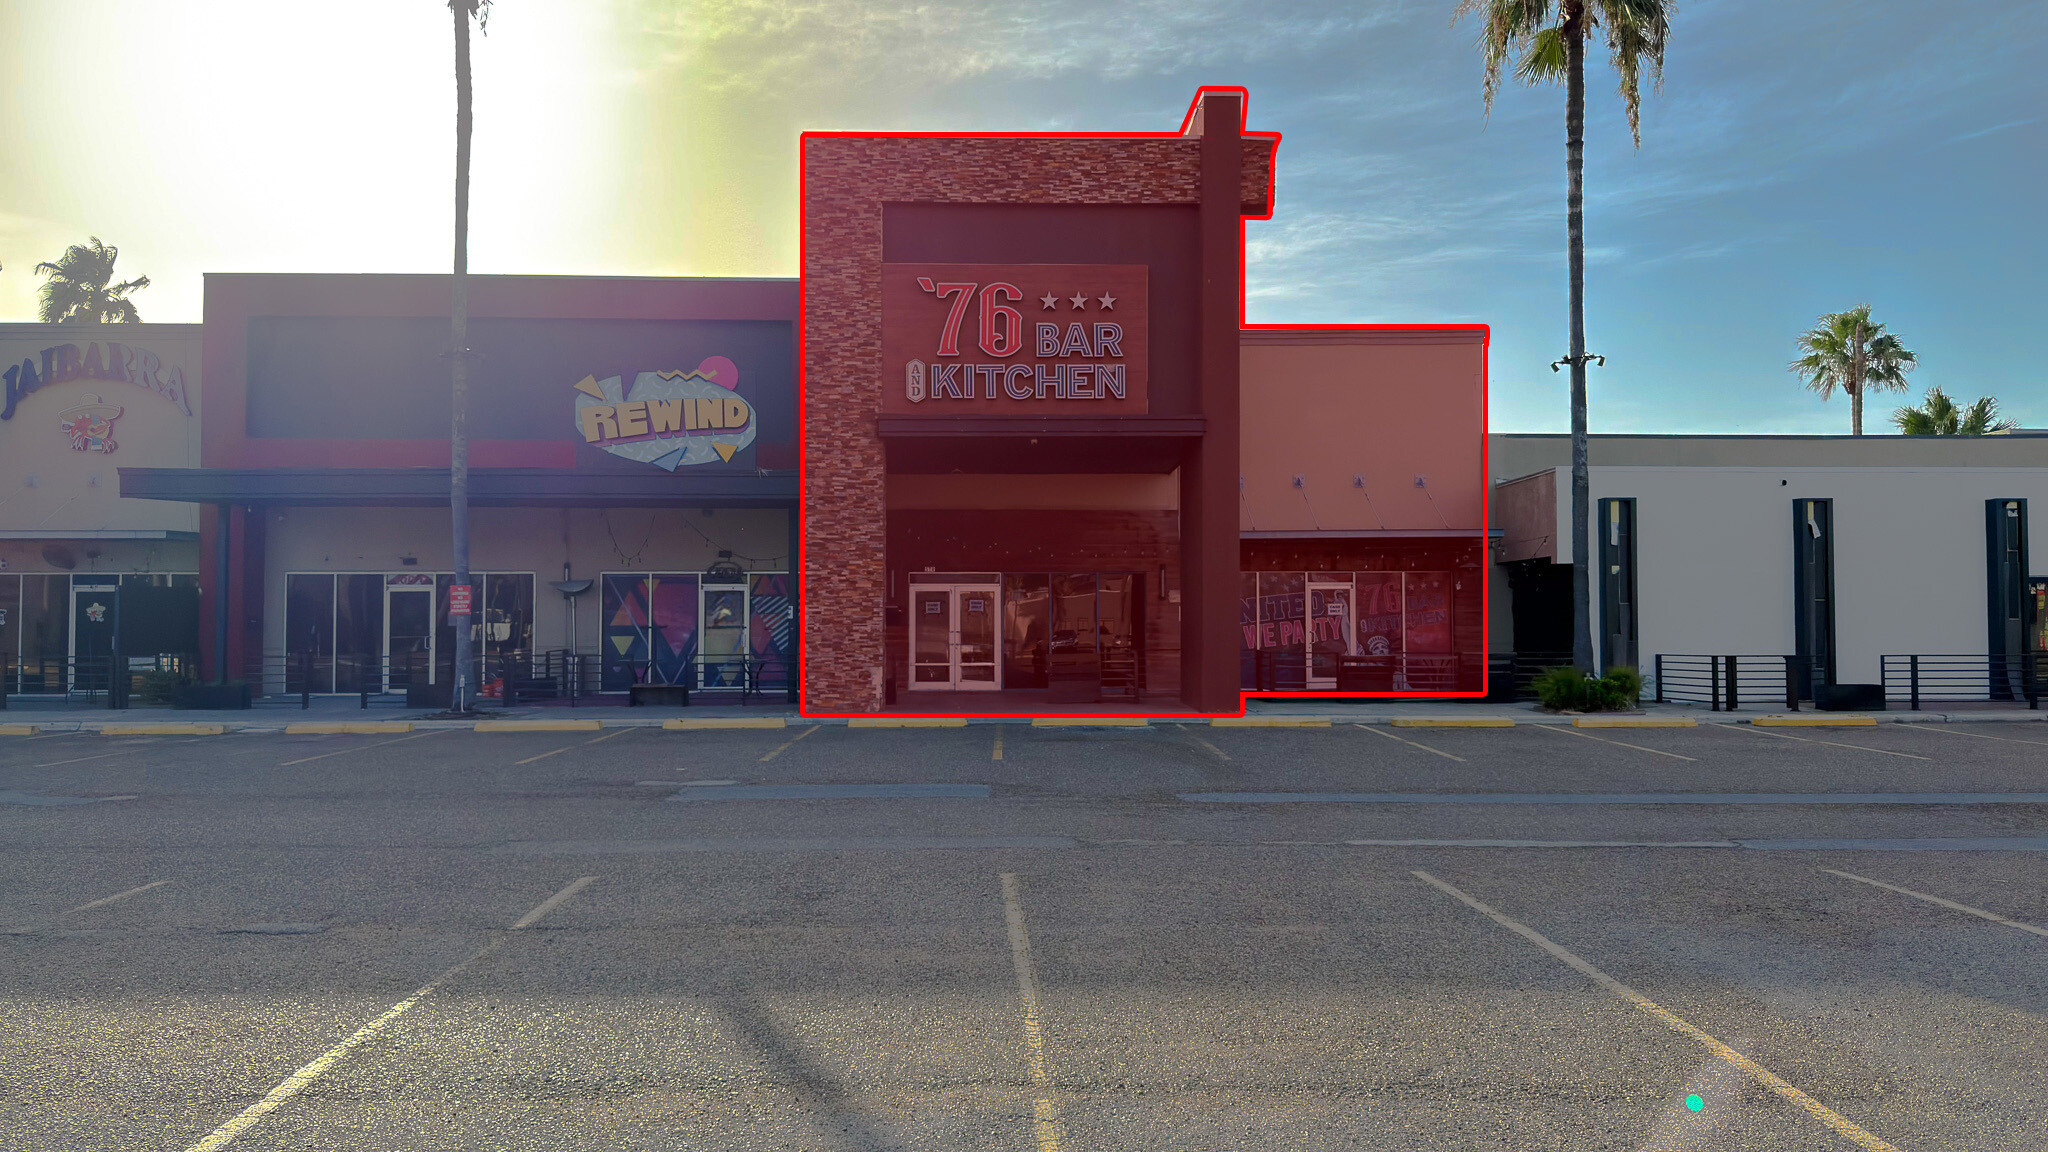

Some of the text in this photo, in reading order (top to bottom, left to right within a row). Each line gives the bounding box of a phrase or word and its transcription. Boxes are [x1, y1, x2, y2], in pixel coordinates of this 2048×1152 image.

[1035, 322, 1124, 358] BAR
[1, 341, 193, 421] JAIBARRA
[911, 364, 921, 397] AND
[931, 364, 1126, 400] KITCHEN
[580, 397, 750, 443] REWIND
[1240, 590, 1325, 624] NITED
[1243, 622, 1276, 649] WE
